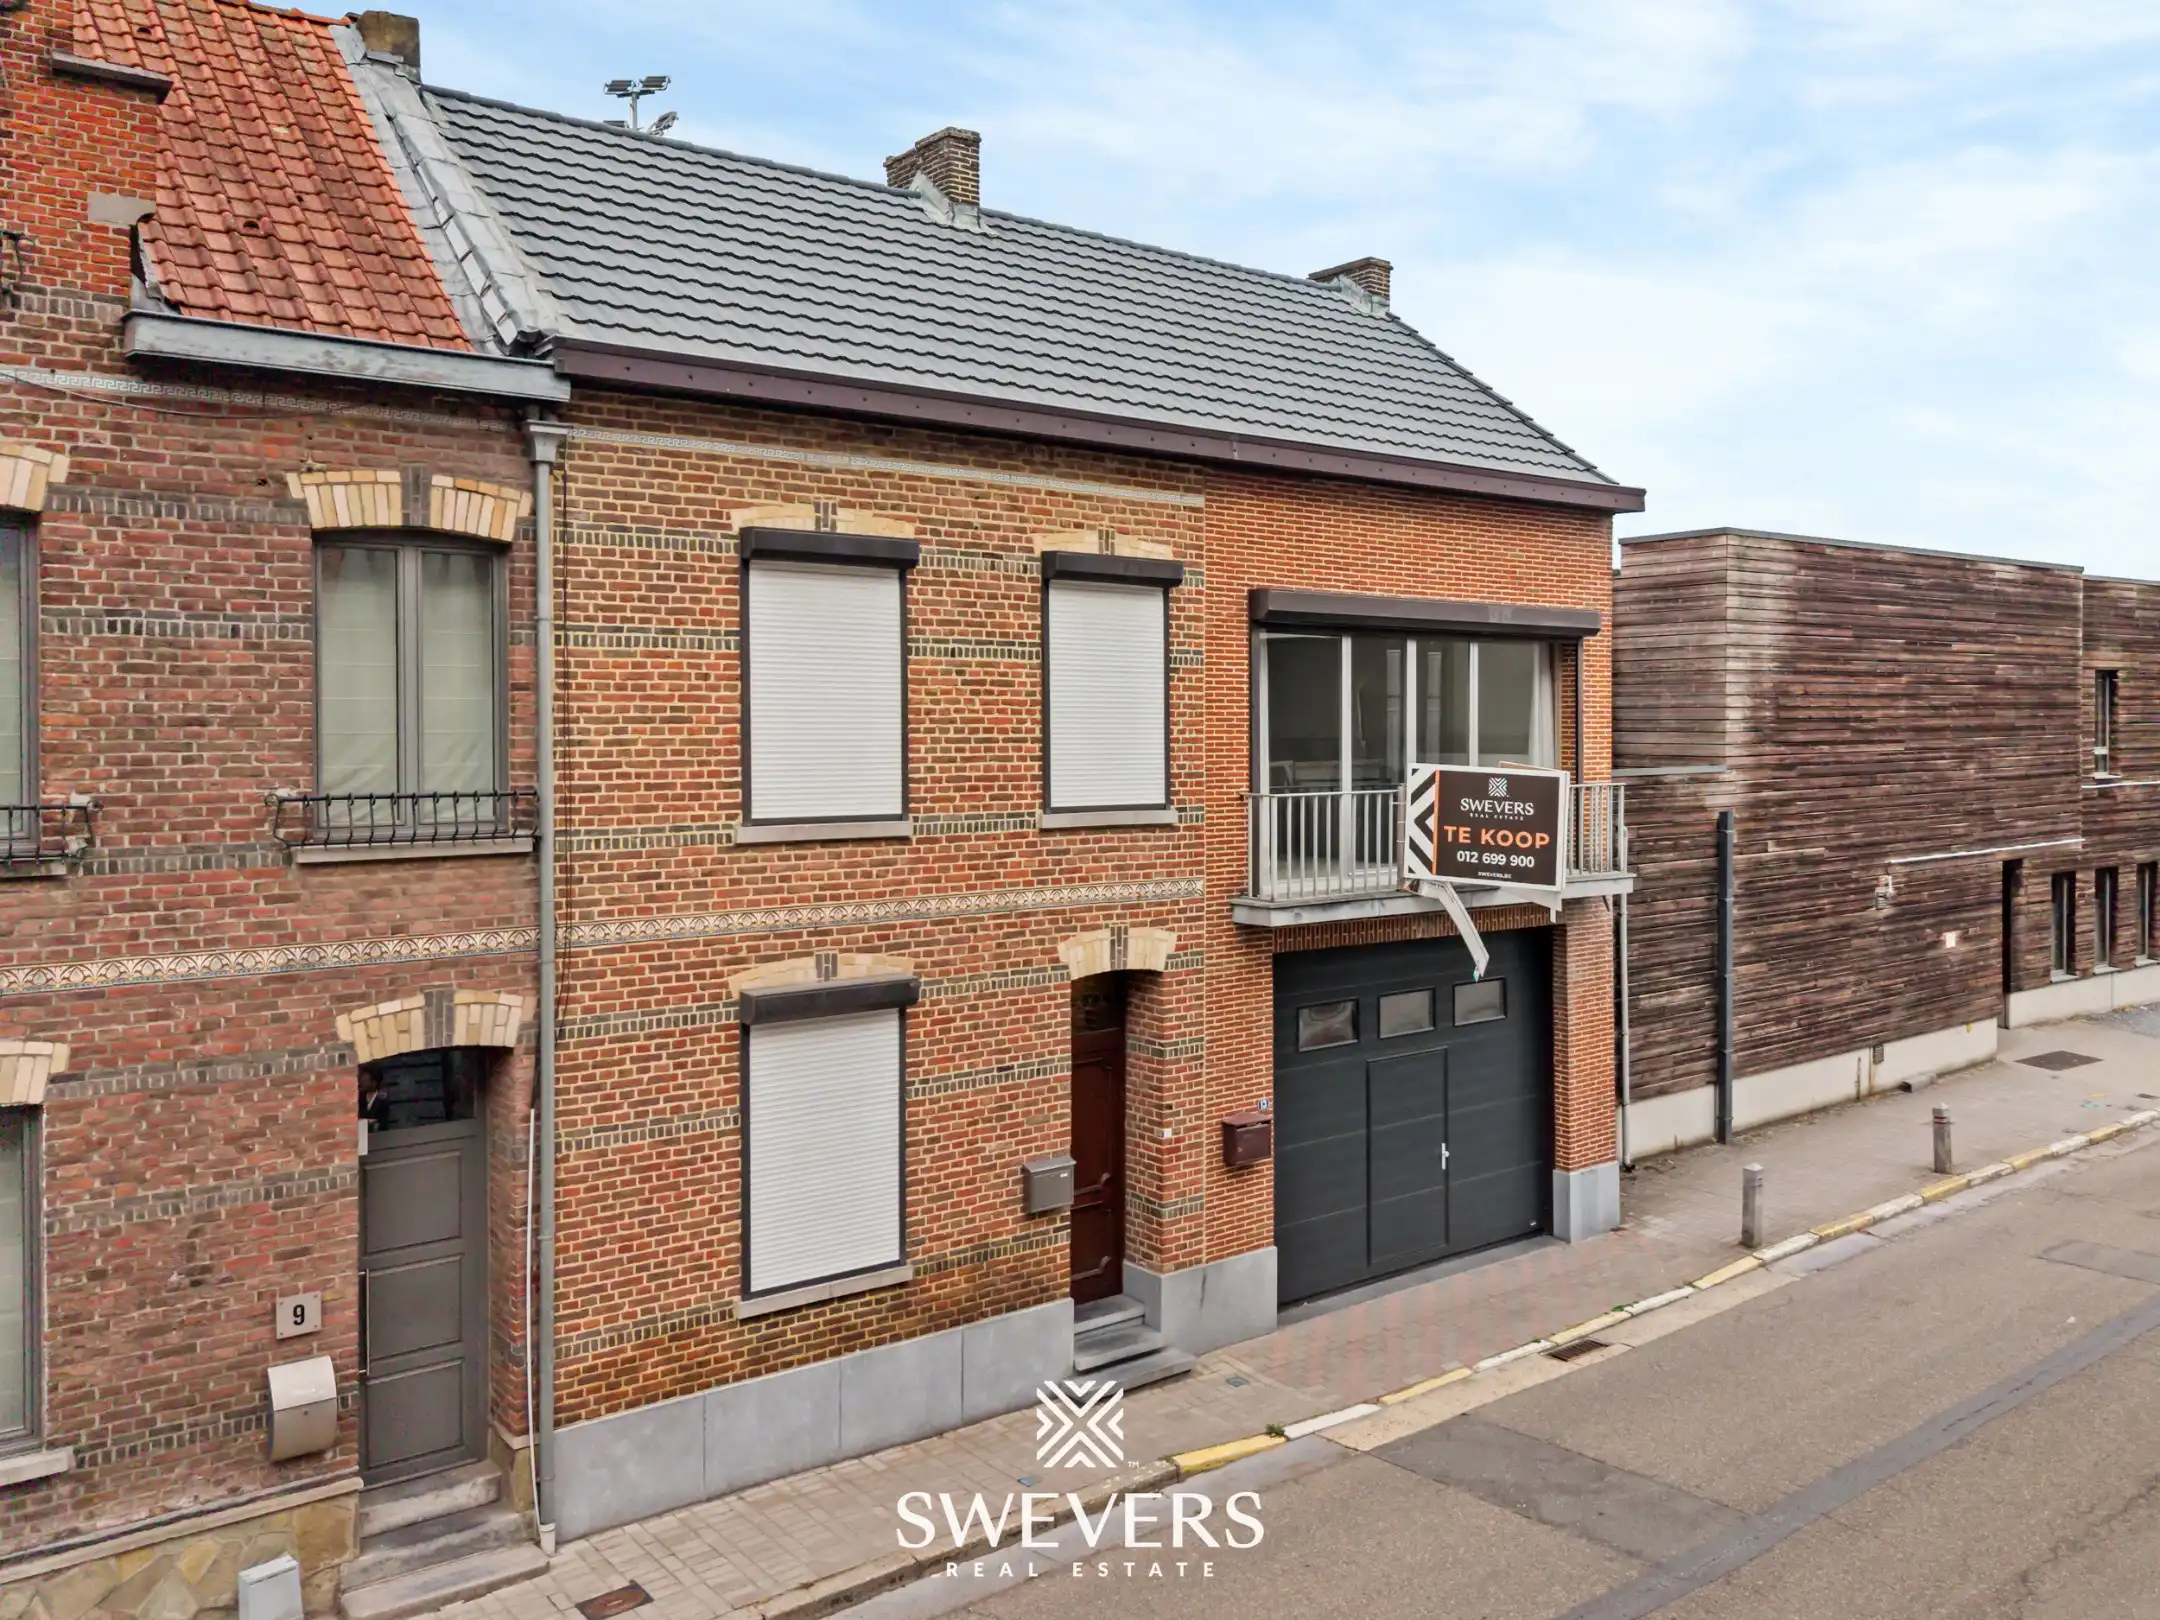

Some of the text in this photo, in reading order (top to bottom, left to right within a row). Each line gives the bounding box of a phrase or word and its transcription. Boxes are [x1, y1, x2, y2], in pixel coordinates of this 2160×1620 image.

[1460, 797, 1535, 816] SWEVERS
[1443, 825, 1550, 849] TE KOOP
[1456, 850, 1535, 868] 012 699 900
[292, 1304, 305, 1326] 9
